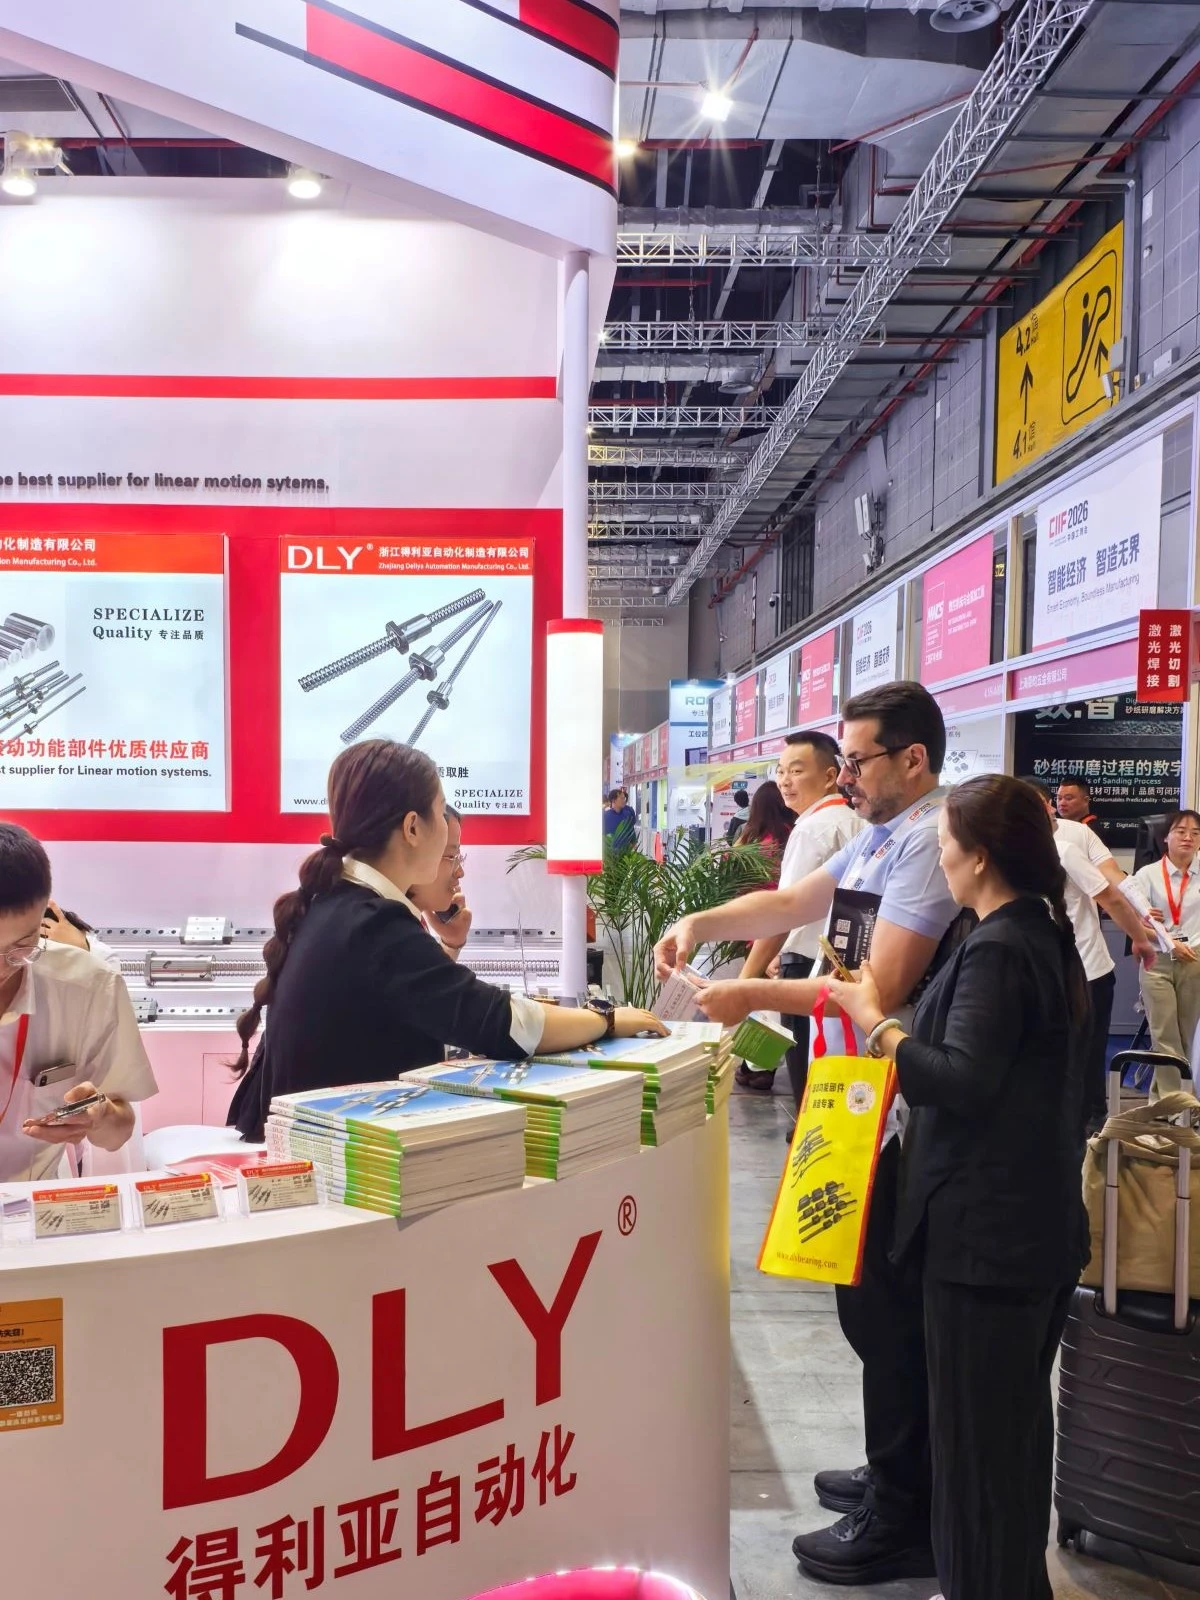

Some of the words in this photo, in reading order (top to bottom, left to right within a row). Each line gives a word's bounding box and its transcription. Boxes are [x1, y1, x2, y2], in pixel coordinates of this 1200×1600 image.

[1016, 327, 1031, 357] 4.2
[1013, 429, 1027, 459] 4.1
[18, 472, 53, 486] best
[57, 472, 122, 489] supplier
[127, 472, 150, 487] for
[154, 472, 199, 488] linear
[204, 474, 262, 488] motion
[287, 545, 364, 570] DLY
[379, 546, 529, 559] 浙江得利亚自动化制造有限公司
[12, 557, 67, 567] Manufacturing
[83, 558, 97, 567] Ltd.
[378, 562, 405, 571] Zhejiang
[425, 562, 461, 570] Automation
[461, 563, 505, 572] Manufacturing
[1047, 556, 1087, 596] 智能经济
[1096, 533, 1140, 577] 智造无界
[93, 608, 205, 621] SPECIALIZE
[93, 625, 153, 641] Quality
[159, 629, 204, 640] 专注品质
[1146, 624, 1162, 688] 激光焊接
[1167, 624, 1182, 688] 激光切割
[9, 764, 55, 777] supplier
[58, 764, 74, 776] for
[78, 765, 113, 777] Linear
[117, 766, 158, 777] motion
[161, 767, 212, 779] systems.
[1102, 777, 1132, 786] Sanding
[1134, 777, 1162, 785] Process
[454, 789, 523, 798] SPECIALIZE
[454, 800, 492, 810] Quality
[163, 1231, 602, 1510] DLY
[165, 1424, 577, 1600] 得利亚自动化
